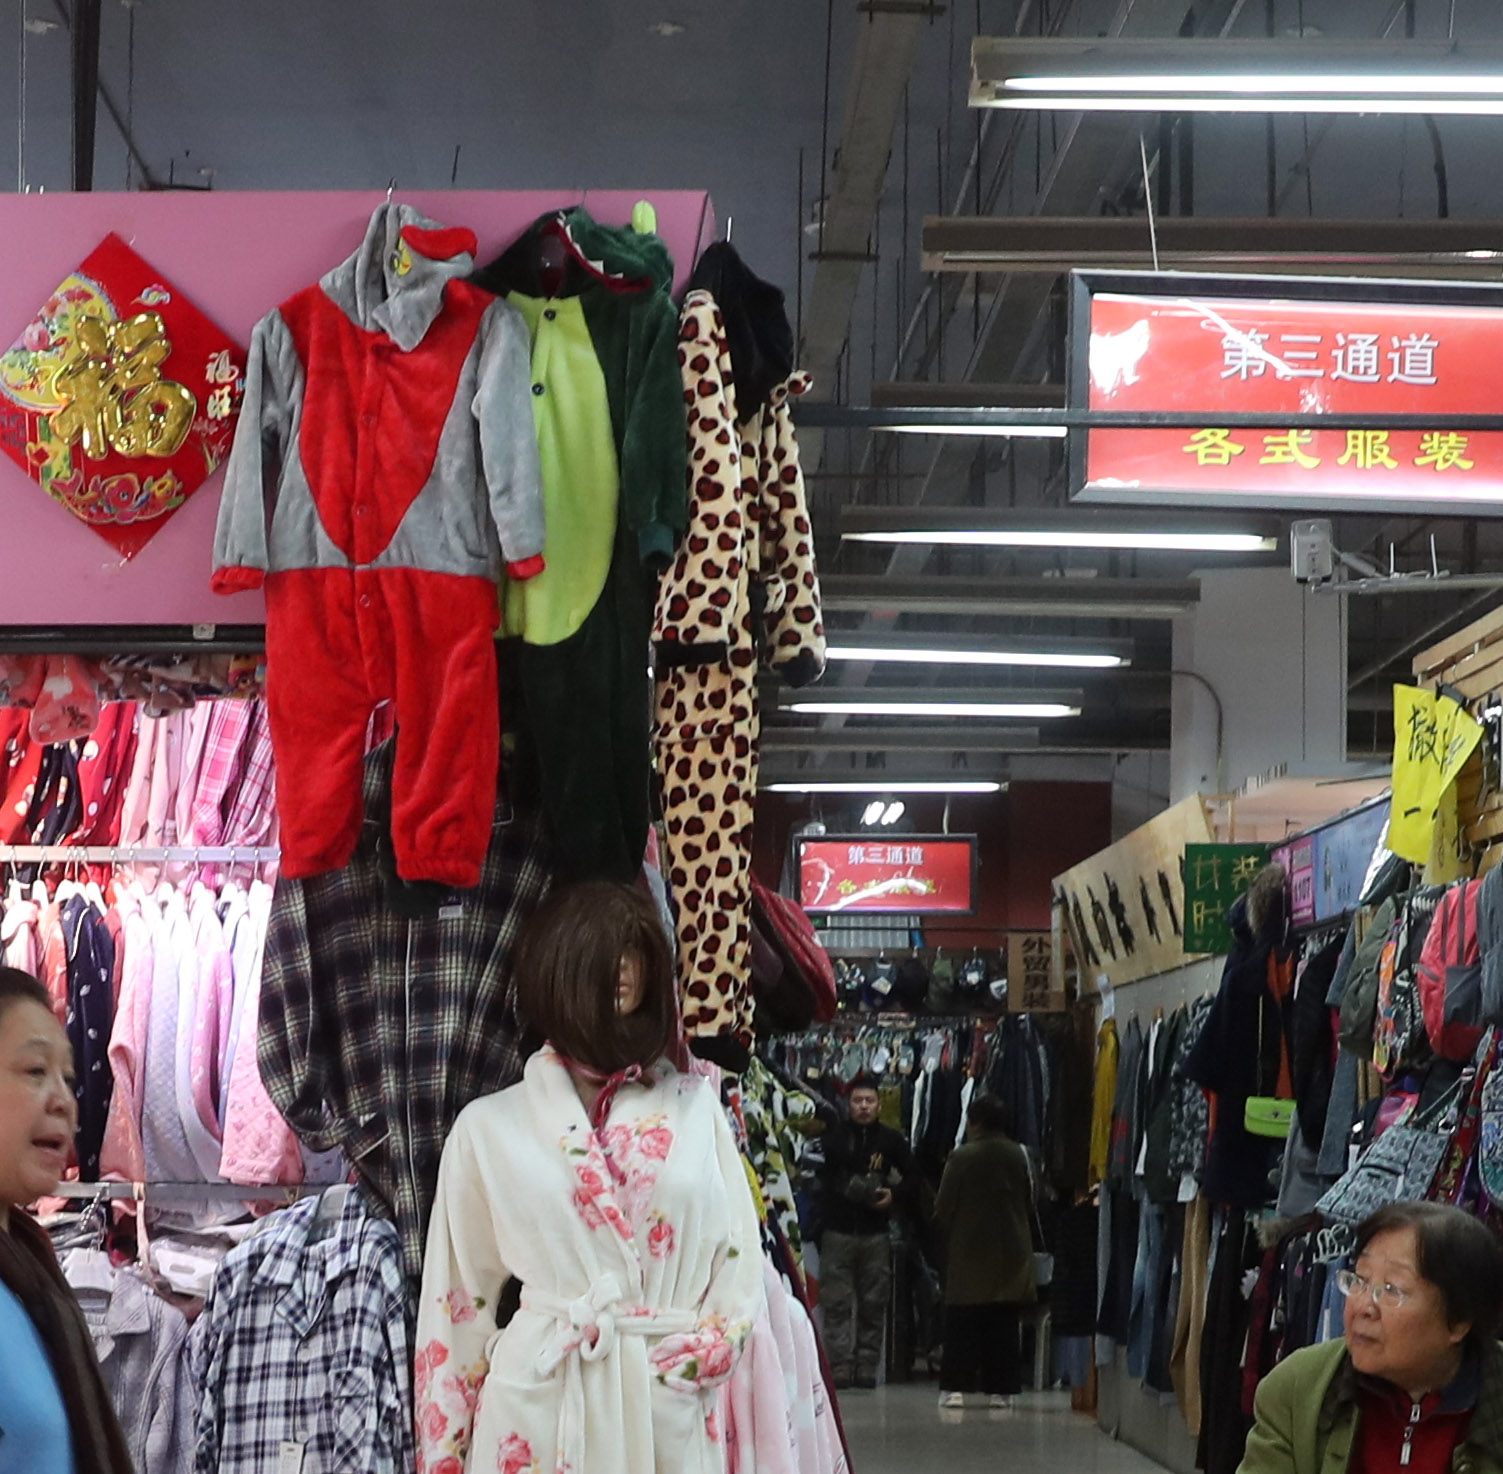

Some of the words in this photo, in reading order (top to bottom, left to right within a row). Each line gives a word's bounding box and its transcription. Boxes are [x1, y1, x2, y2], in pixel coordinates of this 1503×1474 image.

[1219, 329, 1441, 387] 第三通道
[49, 311, 197, 460] 福
[1183, 427, 1476, 472] 各式服装
[848, 845, 924, 865] 第三通道
